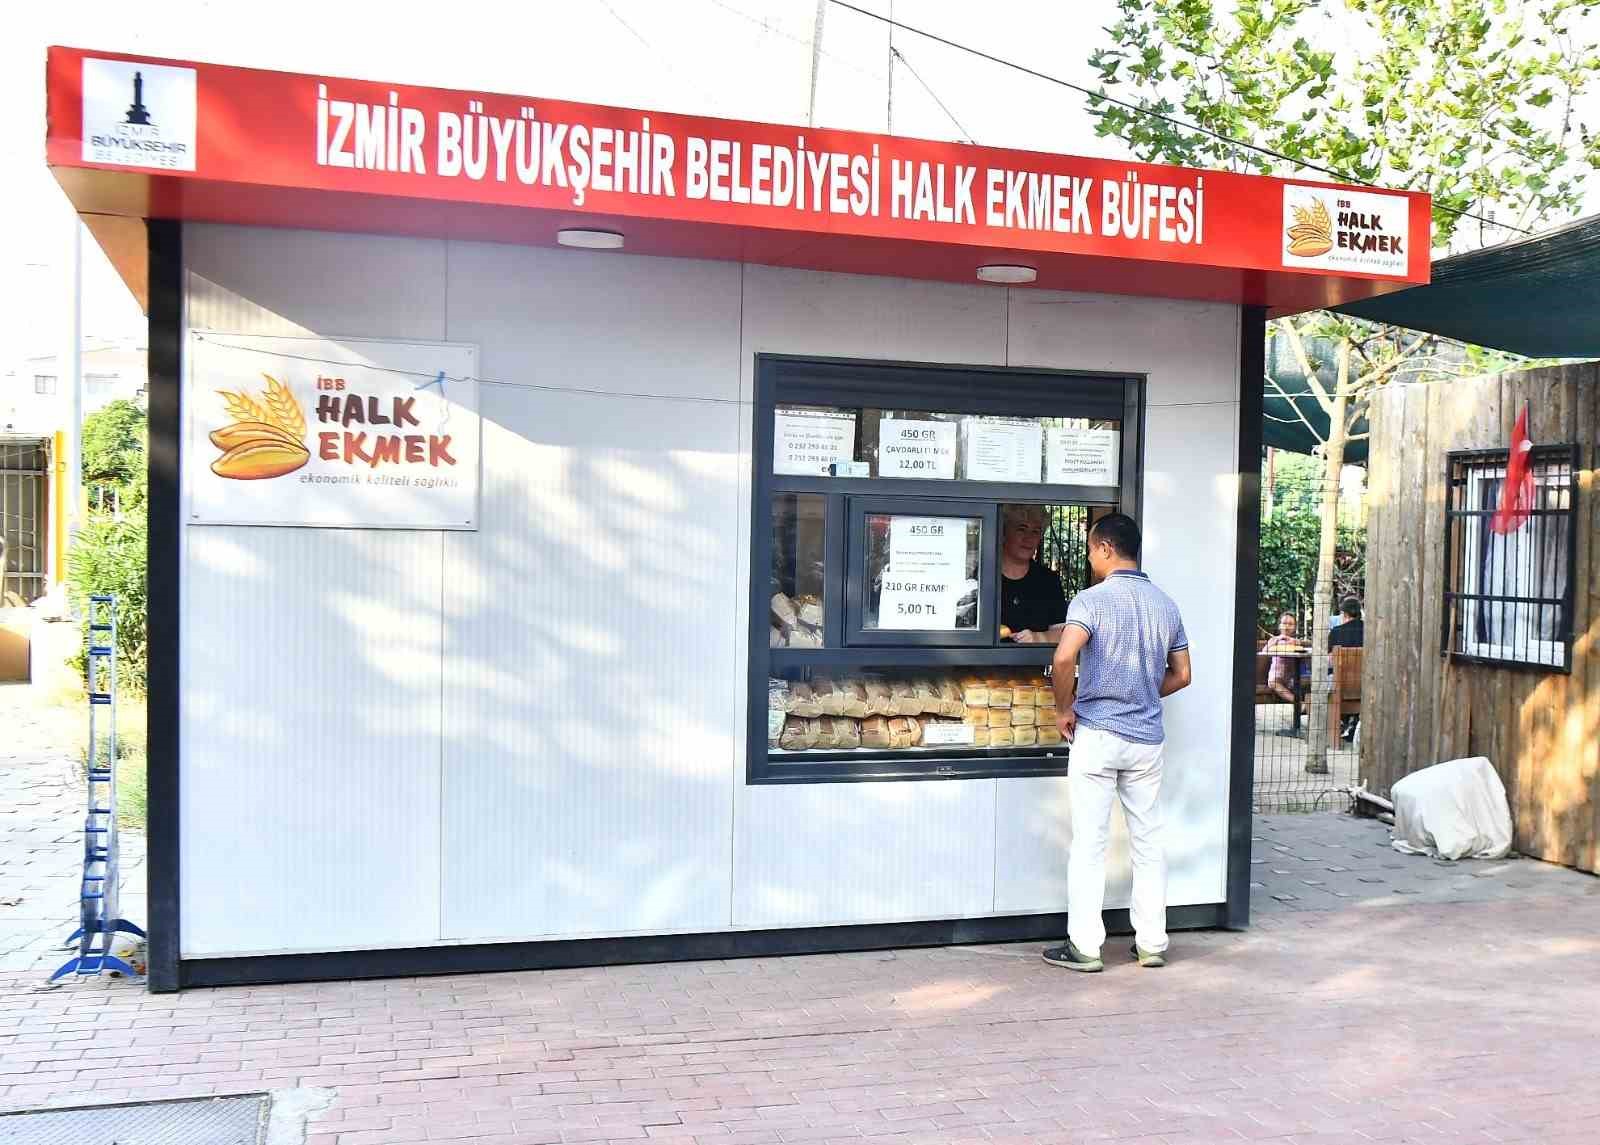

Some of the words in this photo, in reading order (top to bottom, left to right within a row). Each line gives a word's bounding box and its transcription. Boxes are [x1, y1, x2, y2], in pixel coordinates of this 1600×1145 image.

[317, 83, 426, 175] İZMİR
[437, 100, 676, 206] BÜYÜKŞEHİR
[686, 136, 880, 216] BELEDİYESİ
[891, 159, 976, 225] HALK
[986, 168, 1093, 235] EKMEK
[1101, 170, 1204, 245] BÜFESİ
[1337, 211, 1383, 231] HALK
[1337, 231, 1404, 255] EKMEK
[316, 394, 420, 428] HALK
[901, 429, 919, 439] 450
[921, 430, 936, 440] GR
[318, 431, 457, 469] EKMEK
[900, 460, 924, 469] 12,00
[927, 460, 936, 470] TL
[299, 473, 361, 485] ekonomik
[910, 525, 928, 534] 450
[930, 525, 944, 534] GR
[904, 583, 918, 592] GR
[897, 603, 922, 615] 5,00
[925, 604, 937, 615] TL
